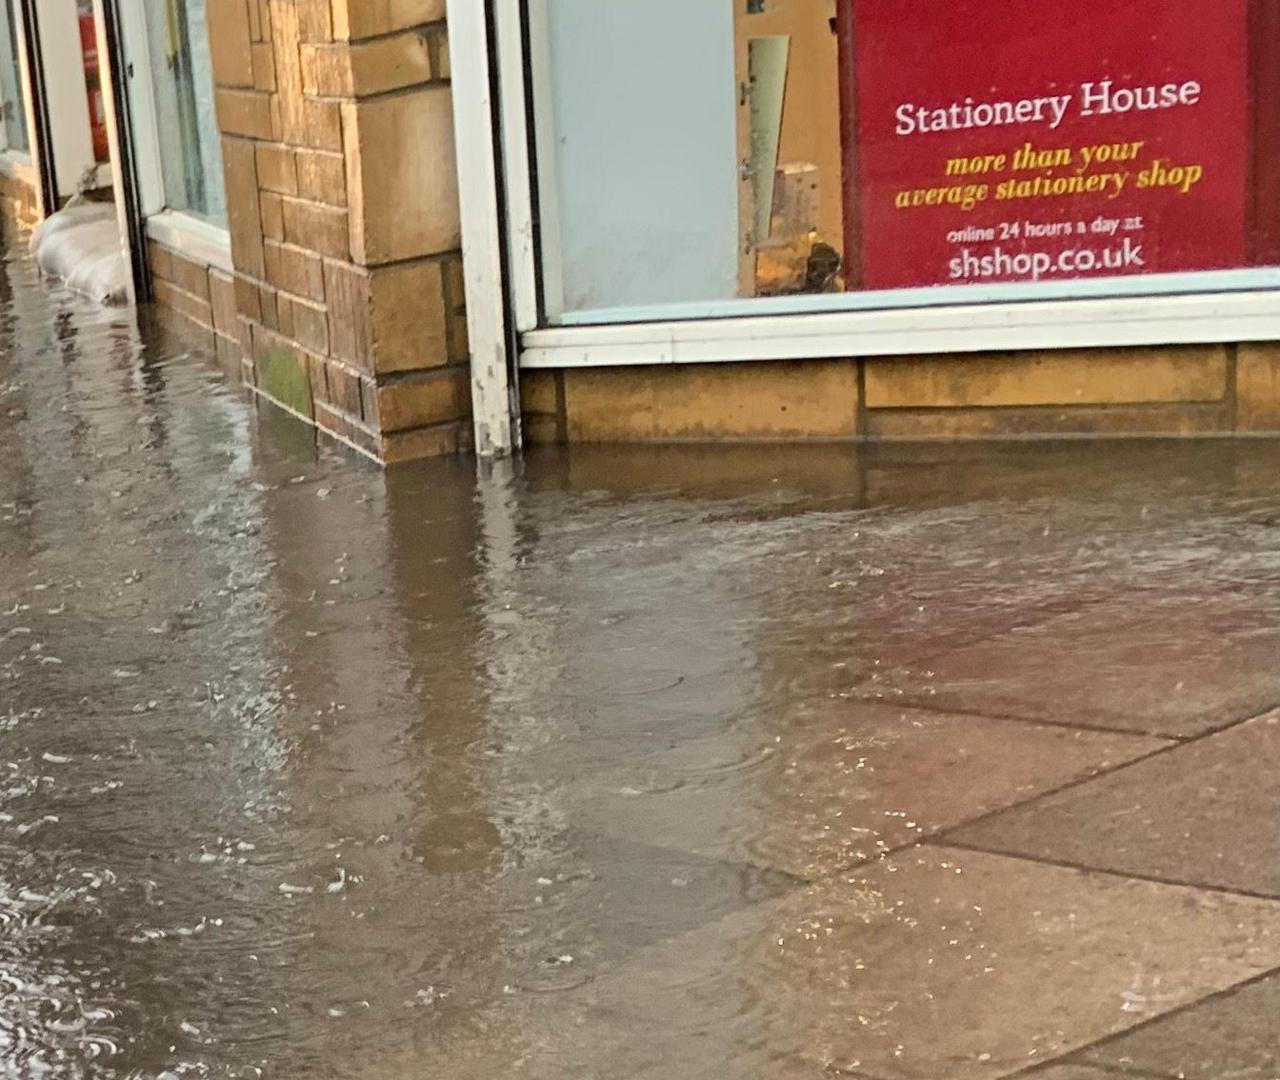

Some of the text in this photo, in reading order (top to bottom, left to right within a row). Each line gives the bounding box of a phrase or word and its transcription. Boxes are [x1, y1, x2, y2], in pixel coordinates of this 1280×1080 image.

[895, 79, 1201, 136] Stationery House
[945, 140, 1144, 177] more than your
[895, 159, 1203, 211] average stationery shop
[946, 215, 1144, 244] online 24 hours a day at
[948, 237, 1145, 281] shshop.co.uk
